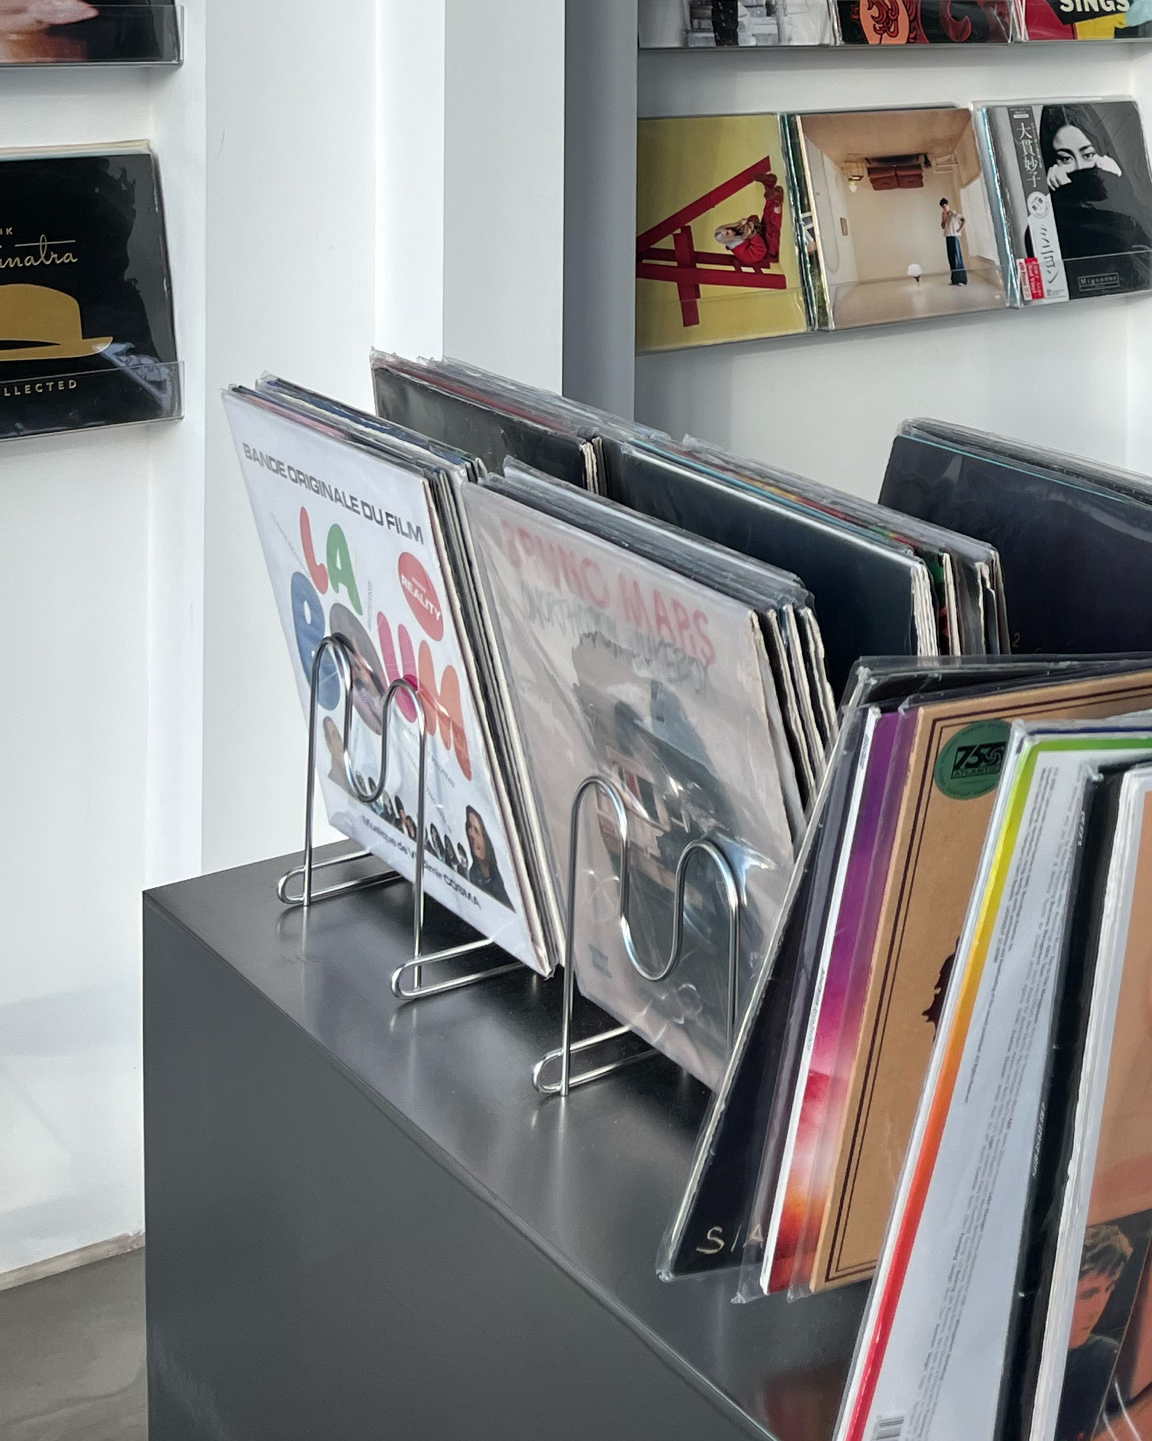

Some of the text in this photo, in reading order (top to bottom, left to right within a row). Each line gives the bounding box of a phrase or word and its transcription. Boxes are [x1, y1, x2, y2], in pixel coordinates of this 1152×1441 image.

[1016, 122, 1041, 188] 大貫妙子
[0, 234, 78, 269] natra
[4, 379, 77, 396] LLECTED
[242, 442, 424, 545] BANDE ORIGINALE DU FILM
[401, 573, 441, 621] REALITY
[618, 570, 716, 665] MARS
